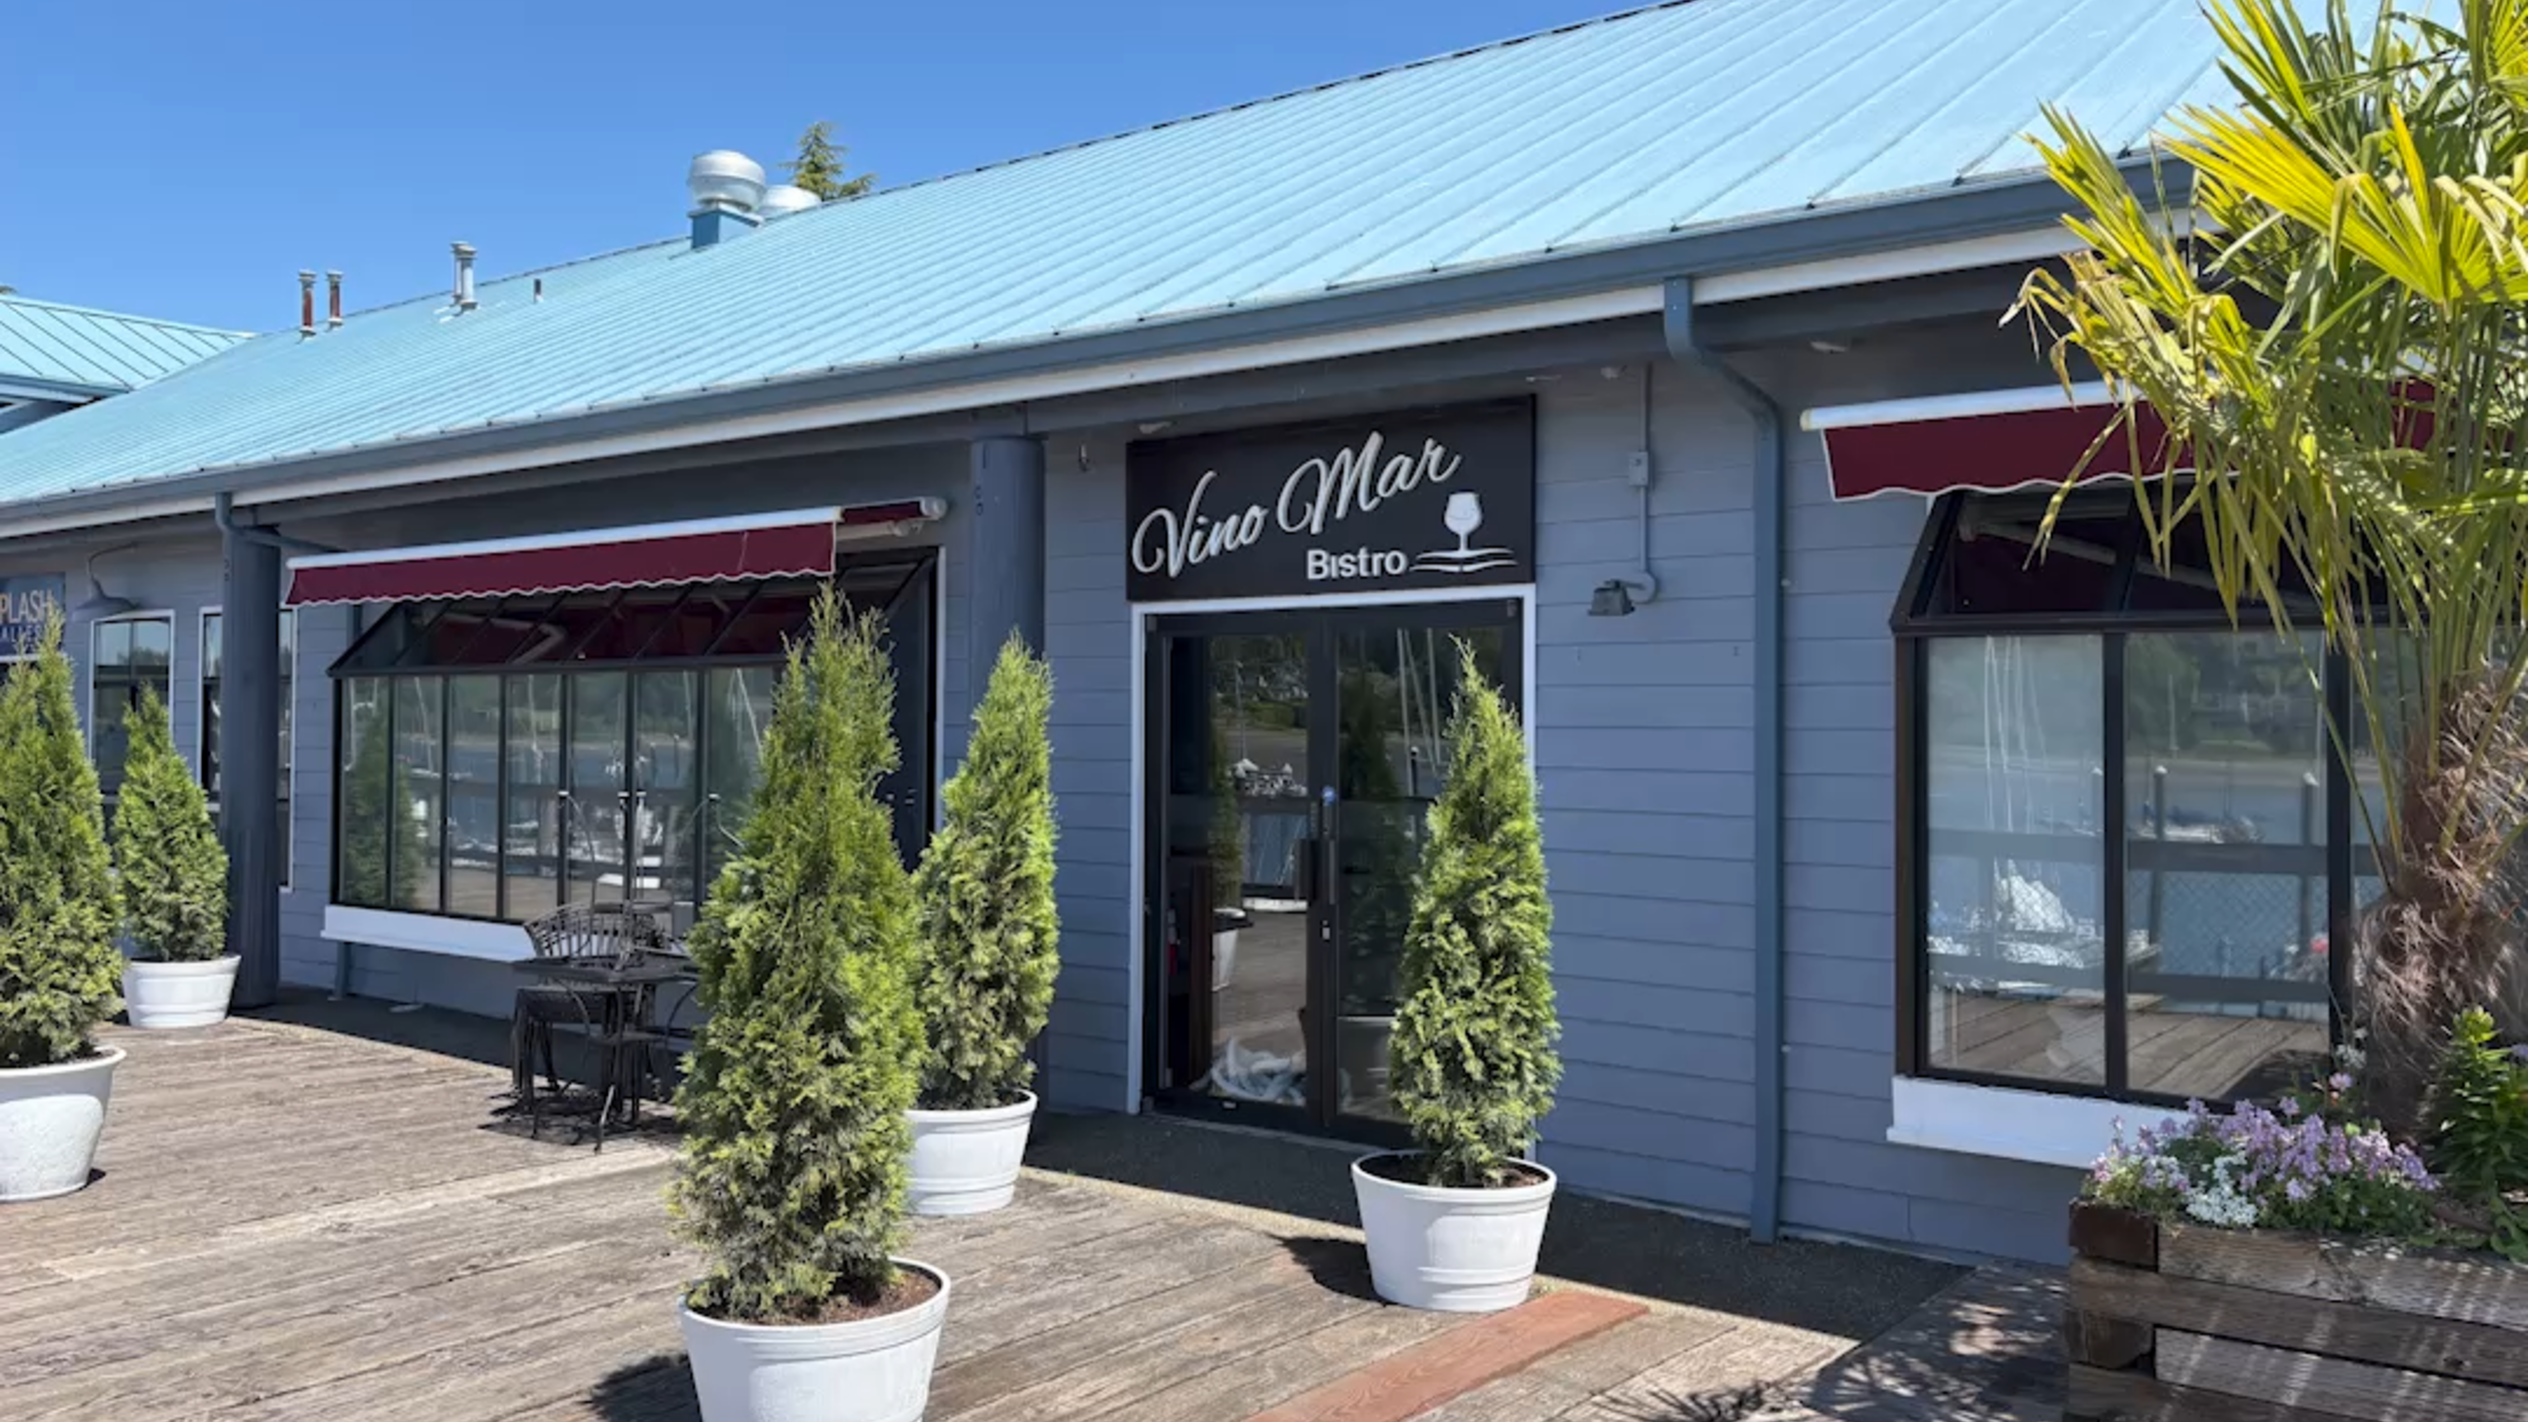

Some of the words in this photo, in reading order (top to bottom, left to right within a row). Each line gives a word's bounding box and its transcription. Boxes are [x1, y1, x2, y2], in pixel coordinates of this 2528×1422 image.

[1132, 470, 1269, 577] Vino
[1277, 431, 1461, 534] Mar
[1306, 547, 1408, 580] Bistro
